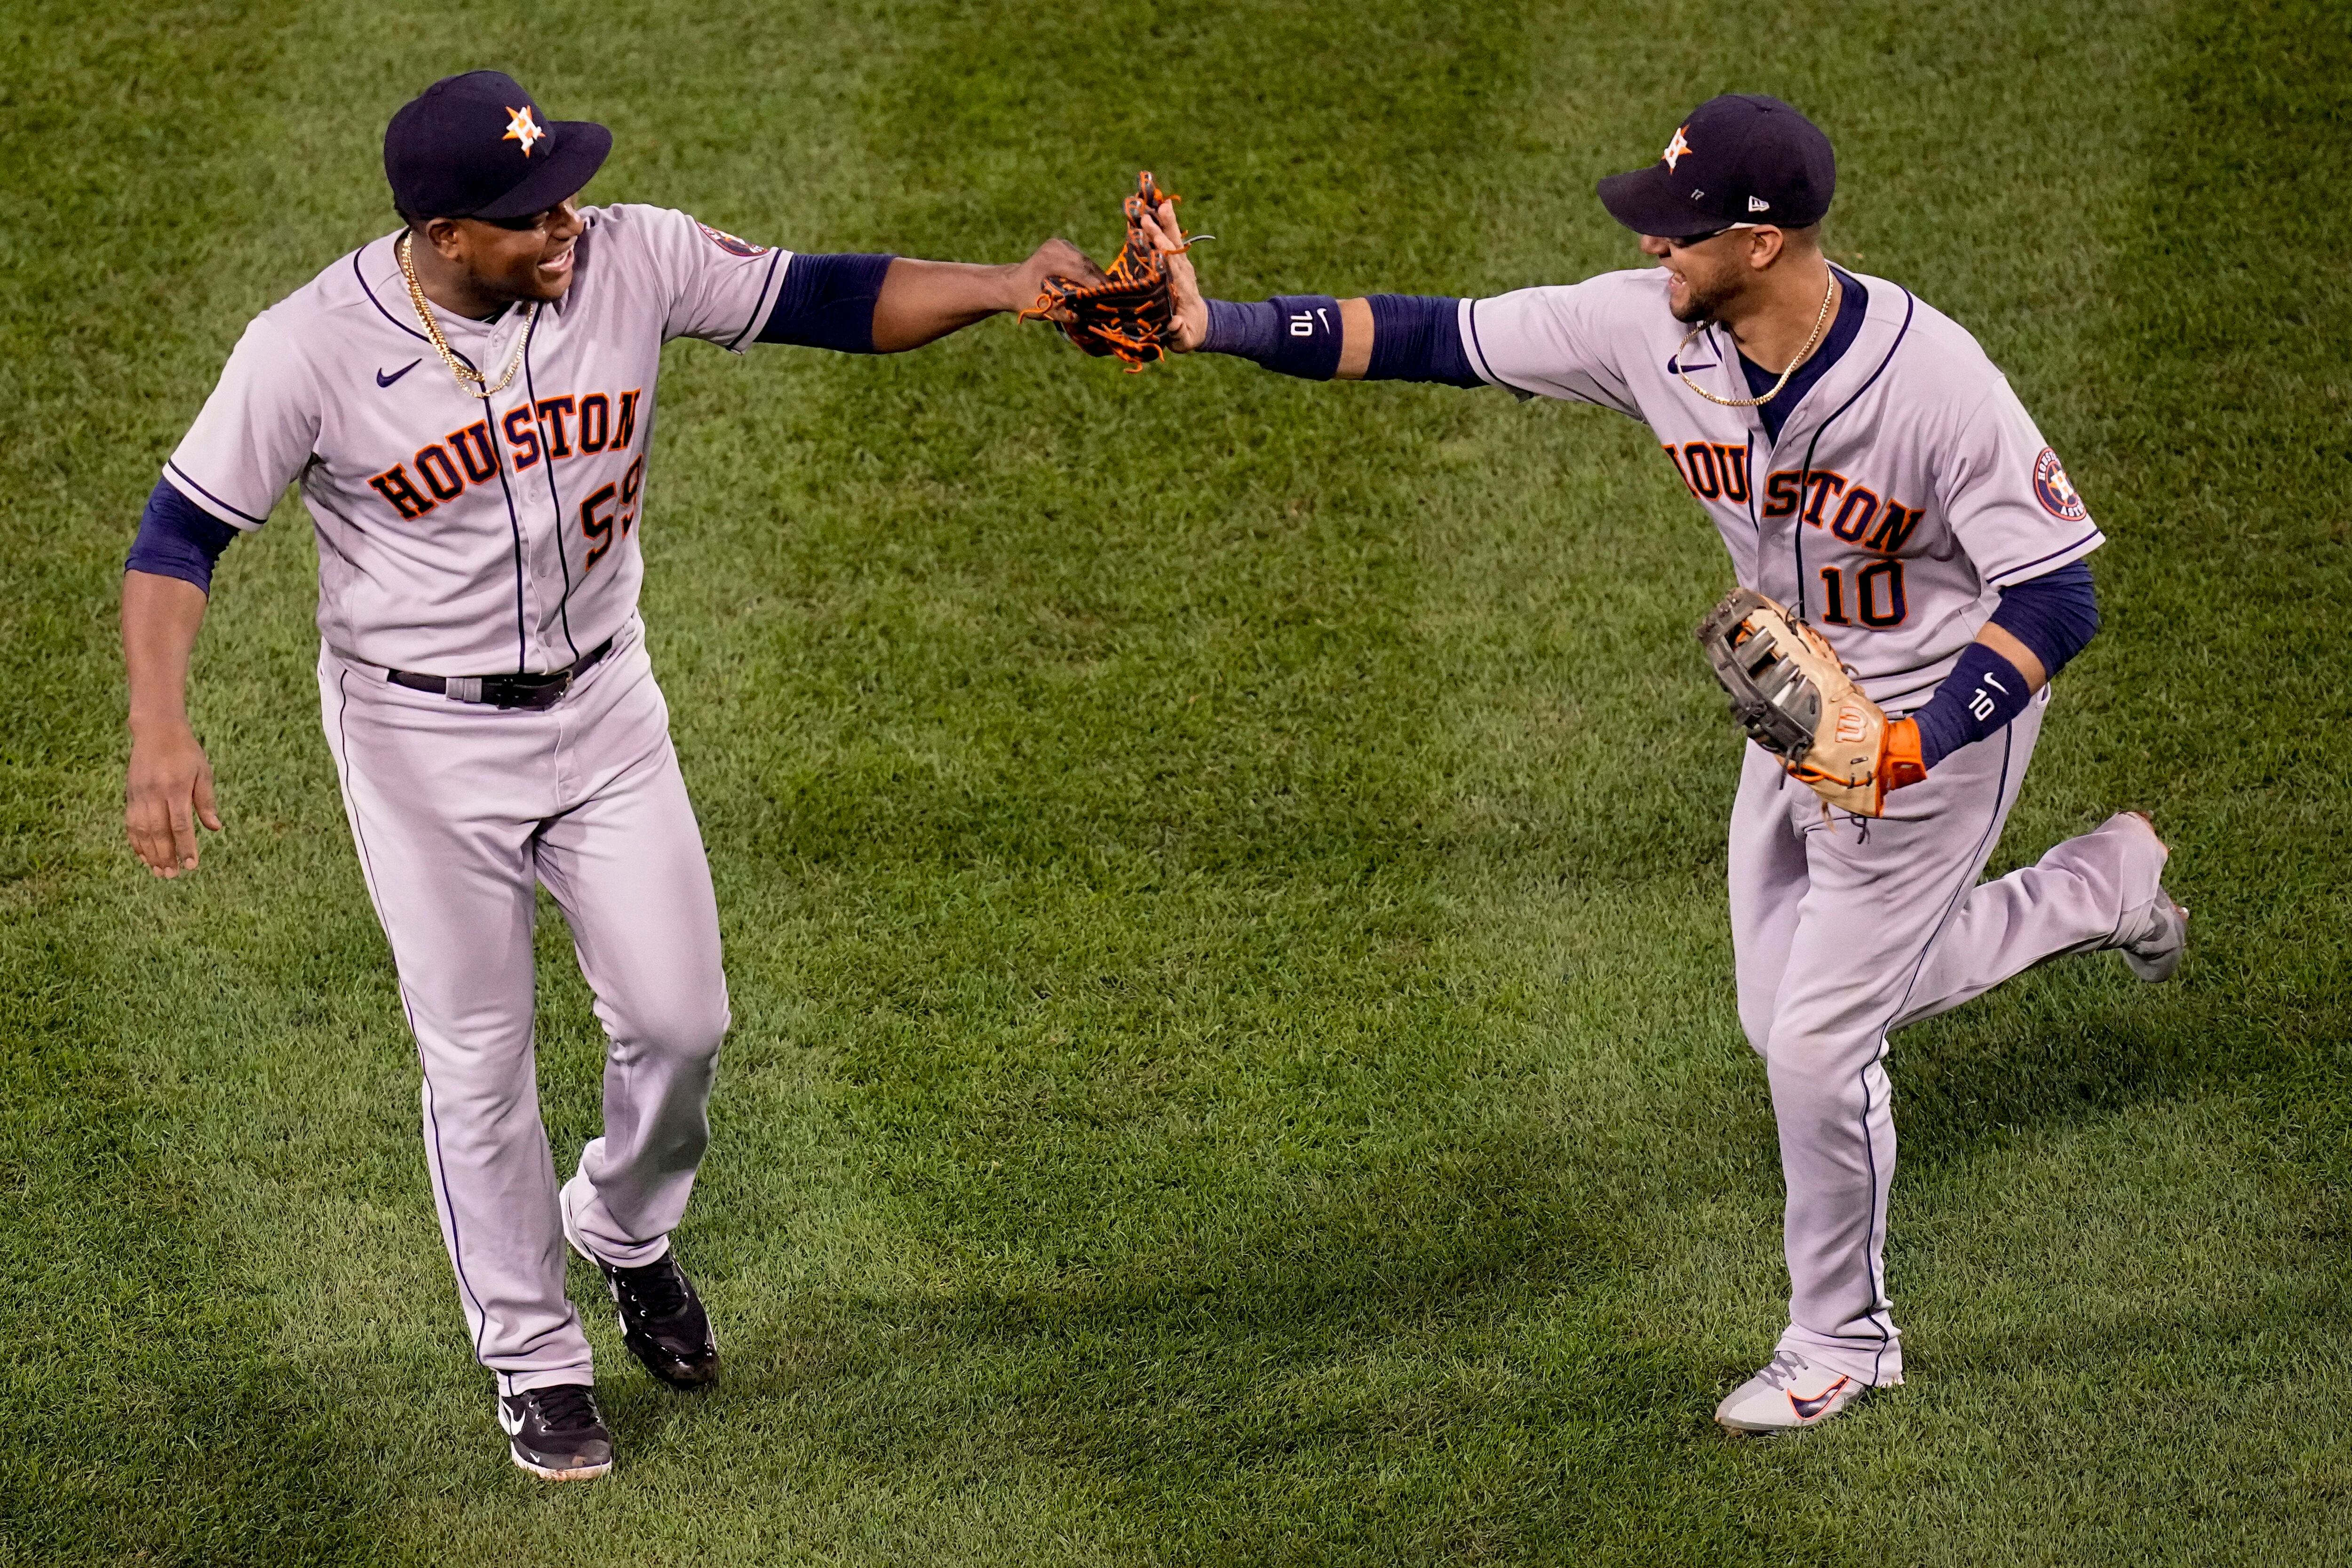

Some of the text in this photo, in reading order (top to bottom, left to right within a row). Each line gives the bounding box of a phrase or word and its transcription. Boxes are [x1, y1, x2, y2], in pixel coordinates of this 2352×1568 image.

[1290, 310, 1313, 336] 10
[367, 388, 640, 522] HOUSTON
[580, 454, 643, 572] 59
[1820, 560, 1908, 629] 10
[1968, 688, 1994, 721] 10
